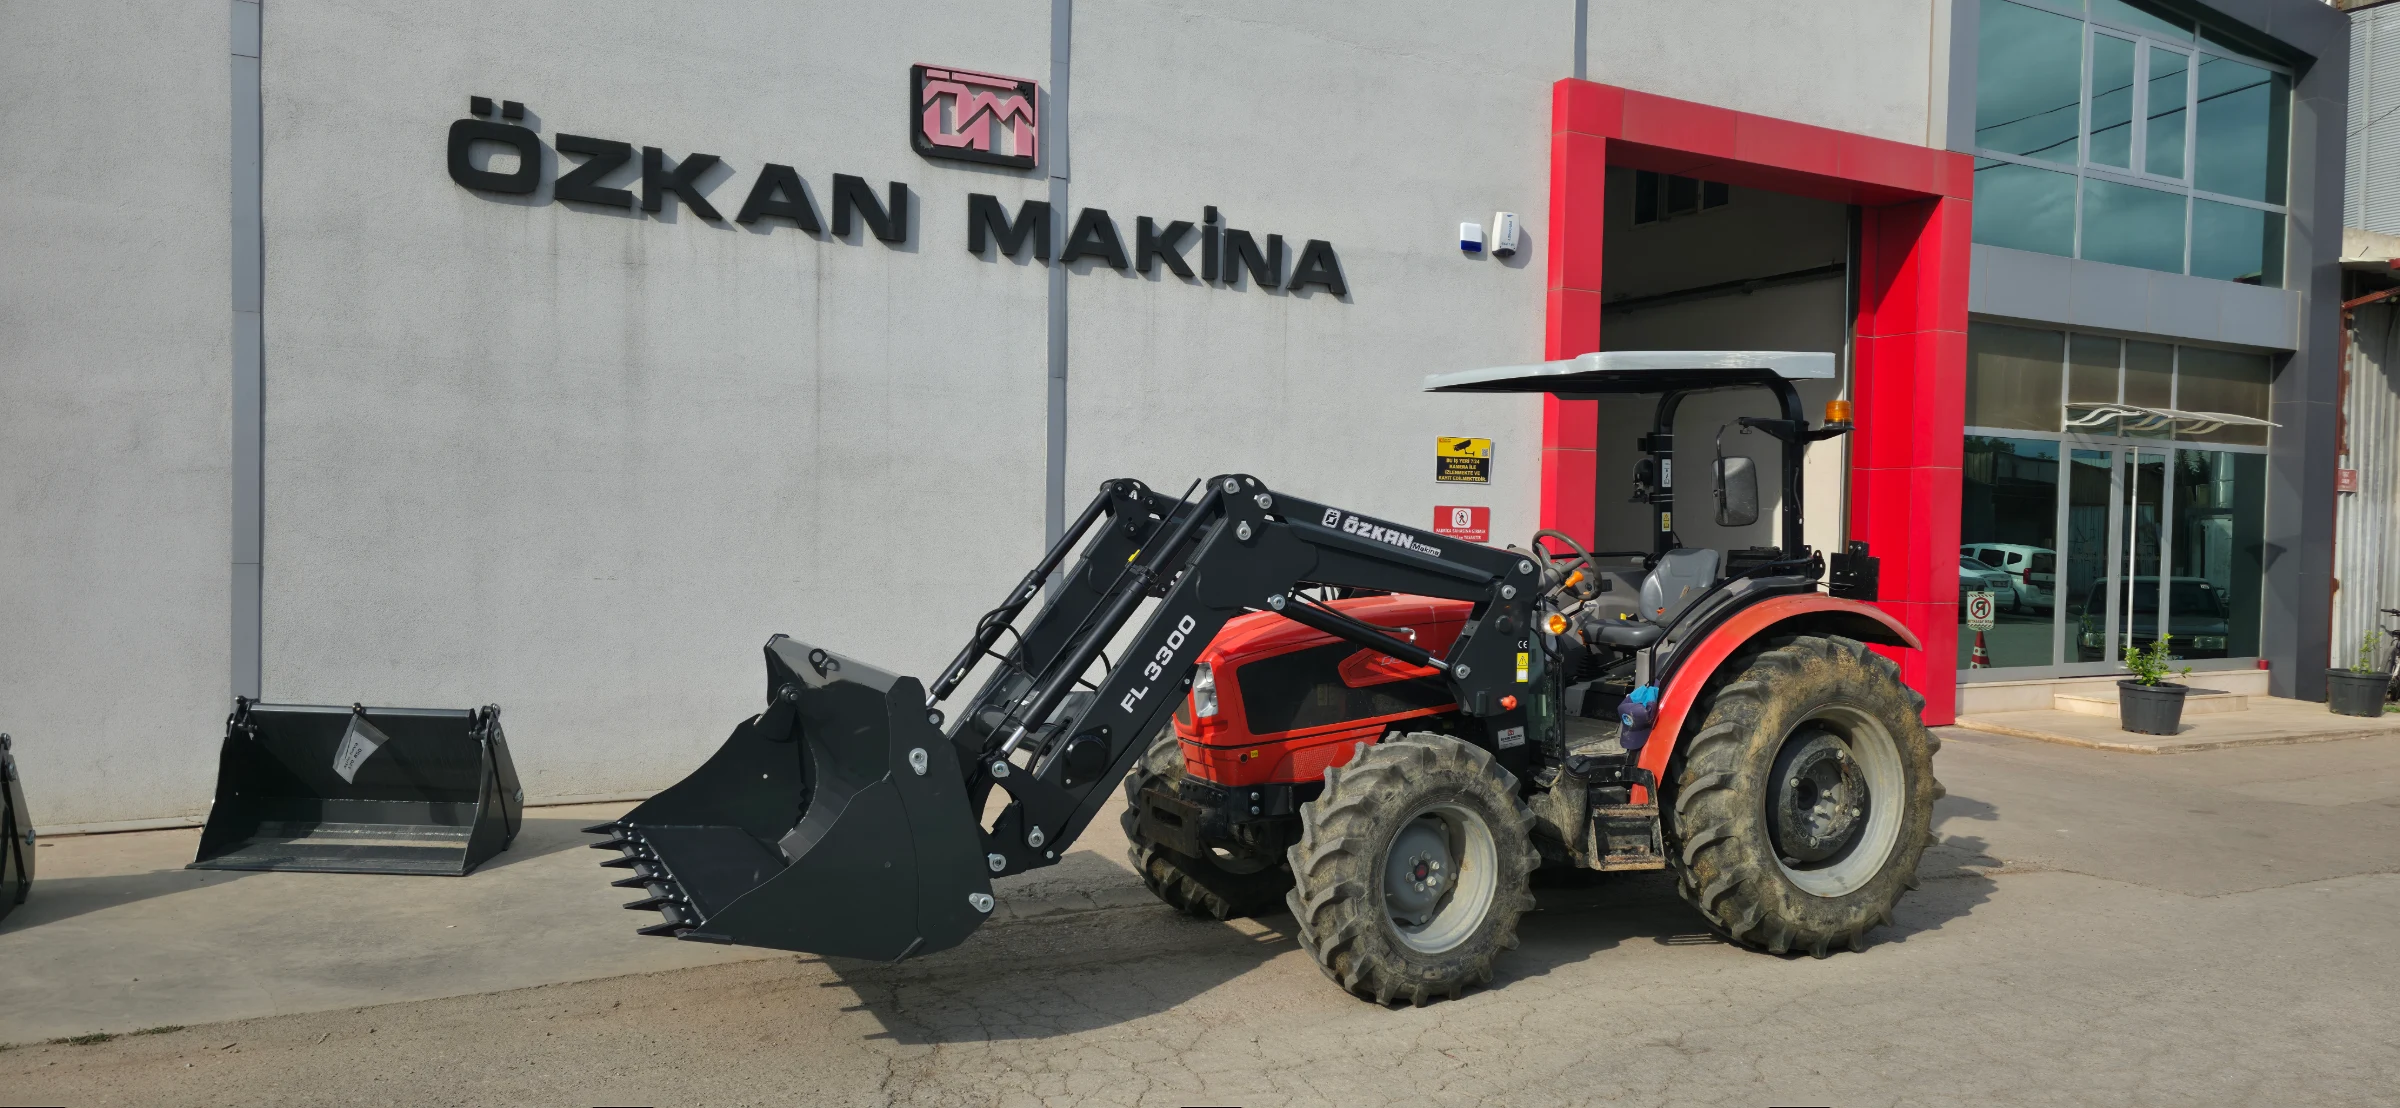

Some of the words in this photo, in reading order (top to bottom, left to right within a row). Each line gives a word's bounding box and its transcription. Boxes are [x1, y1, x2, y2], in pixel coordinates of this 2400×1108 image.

[447, 96, 908, 244] ÖZKAN
[967, 193, 1348, 296] MAKİNA
[1342, 516, 1414, 549] ÖZKAN
[1411, 542, 1441, 557] Makina
[1120, 687, 1149, 713] FL
[1144, 615, 1196, 682] 3300
[1518, 640, 1527, 649] CE
